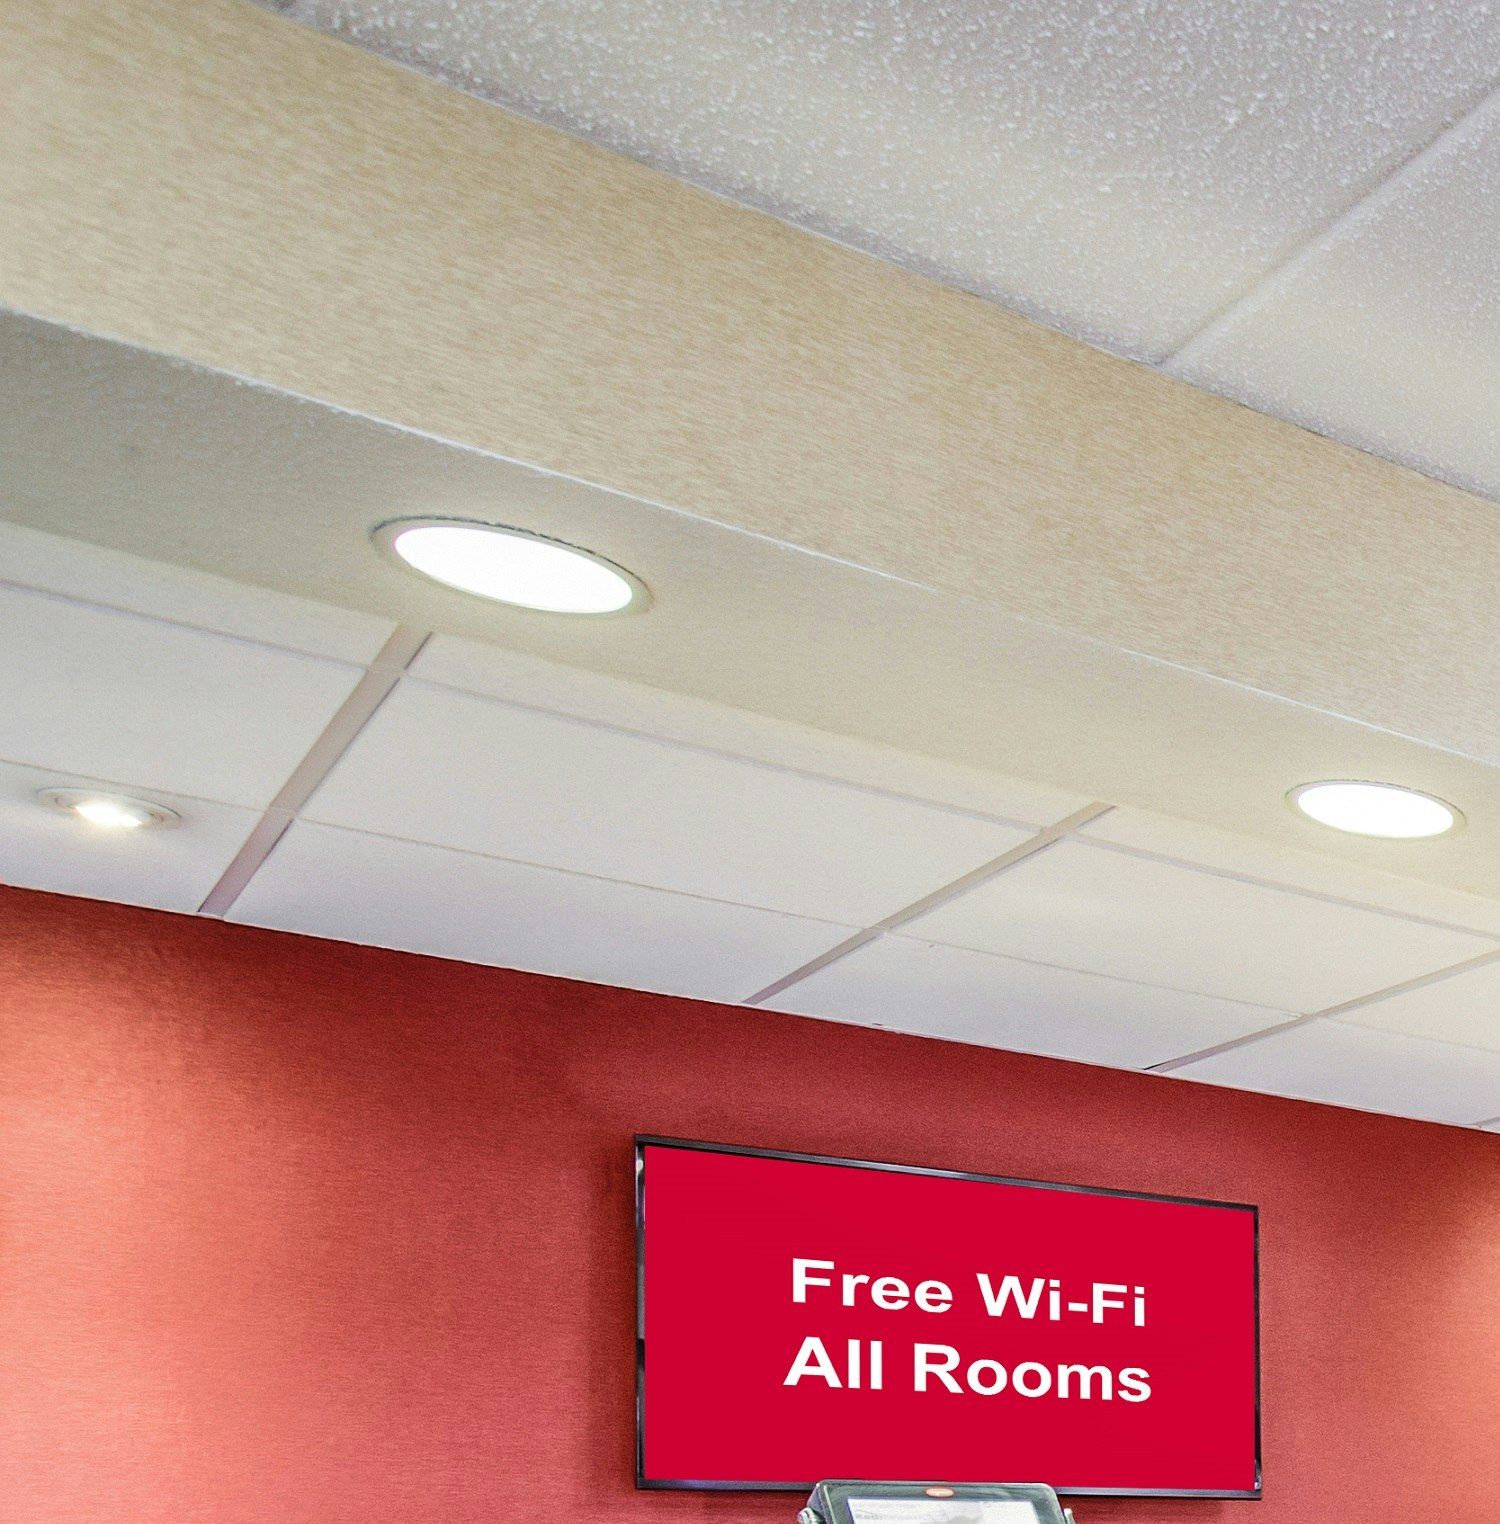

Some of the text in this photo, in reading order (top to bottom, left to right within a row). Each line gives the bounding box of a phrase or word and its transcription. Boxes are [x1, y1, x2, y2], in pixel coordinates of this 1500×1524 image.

[792, 1257, 1145, 1327] Free Wi-Fi
[782, 1335, 1152, 1403] All Rooms
